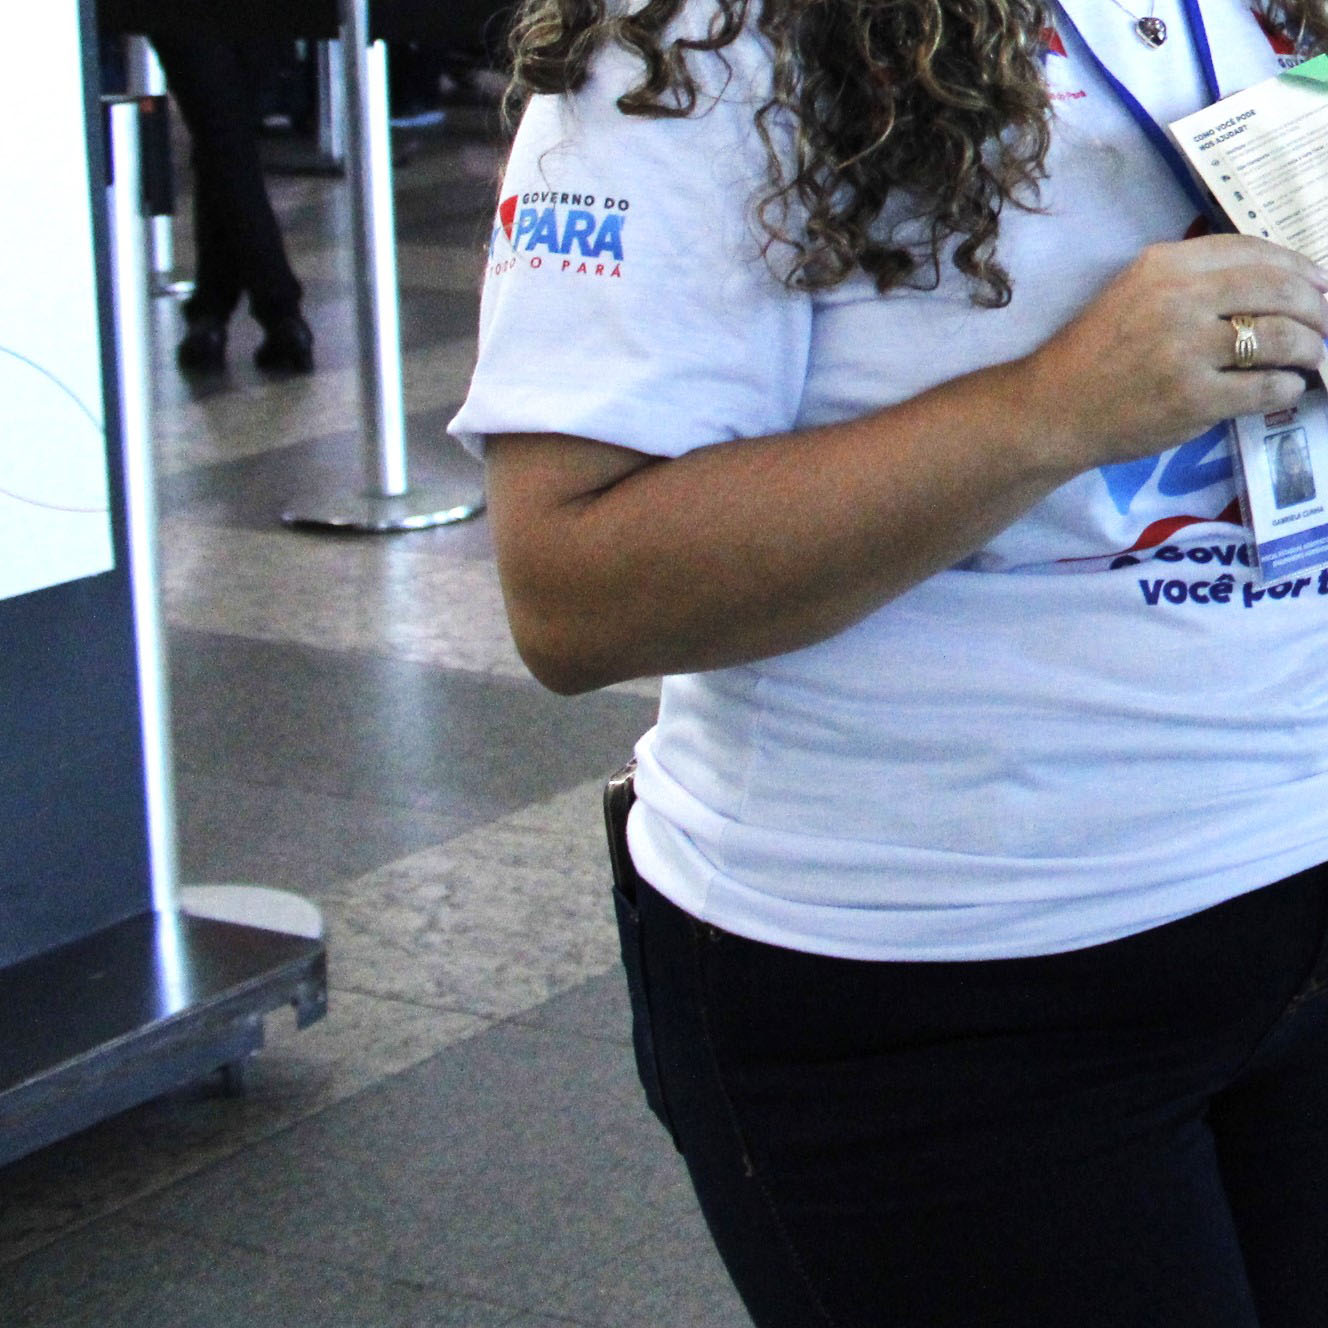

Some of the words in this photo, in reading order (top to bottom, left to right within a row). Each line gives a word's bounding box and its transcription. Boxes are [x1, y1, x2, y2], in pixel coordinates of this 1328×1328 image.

[522, 191, 595, 207] GOVERNO
[603, 197, 631, 212] DO
[1138, 573, 1236, 607] você
